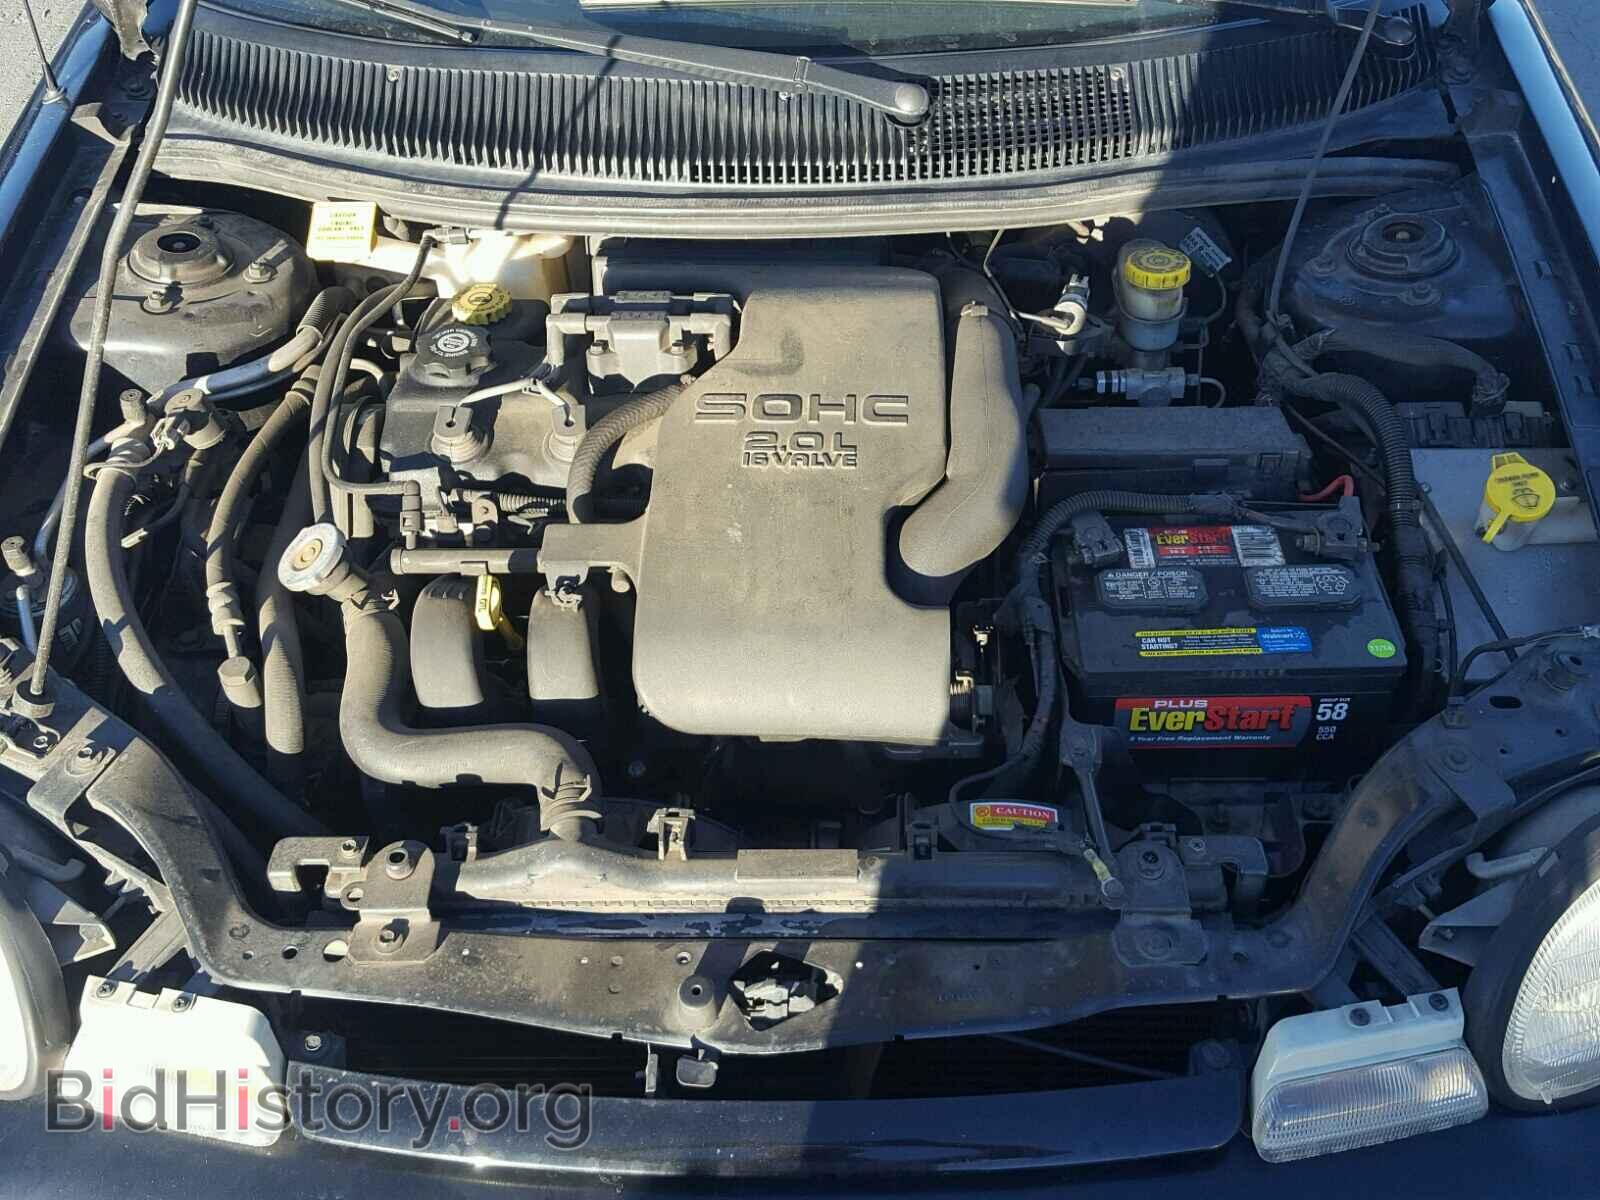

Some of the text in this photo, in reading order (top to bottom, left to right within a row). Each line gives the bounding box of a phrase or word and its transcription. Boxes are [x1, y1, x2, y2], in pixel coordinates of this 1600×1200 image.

[695, 392, 909, 425] SOHC
[1154, 699, 1208, 709] PLUS
[1316, 703, 1349, 720] 58
[1129, 703, 1297, 731] EverStart
[996, 806, 1050, 819] CAUTION
